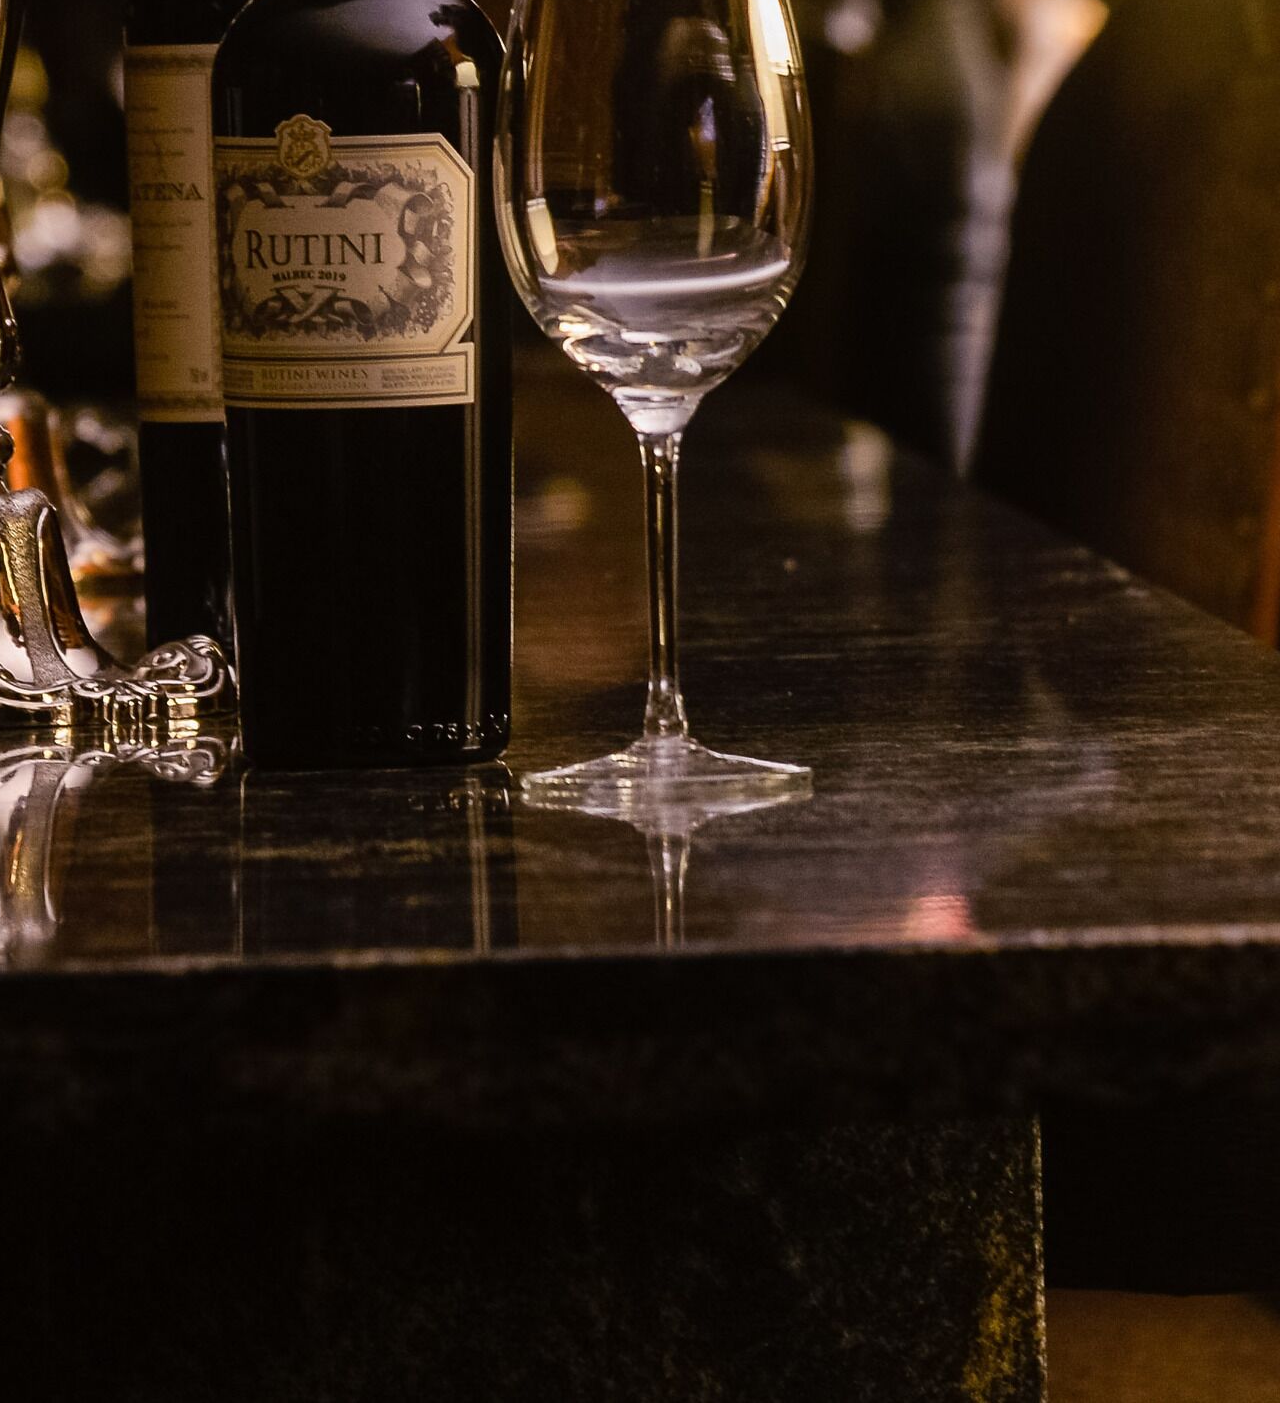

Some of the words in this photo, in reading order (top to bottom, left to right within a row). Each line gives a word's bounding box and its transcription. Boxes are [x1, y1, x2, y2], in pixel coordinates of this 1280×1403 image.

[244, 228, 385, 271] RUTINI
[271, 269, 315, 283] MALBEC
[319, 270, 347, 282] 2019
[314, 368, 369, 380] WINES
